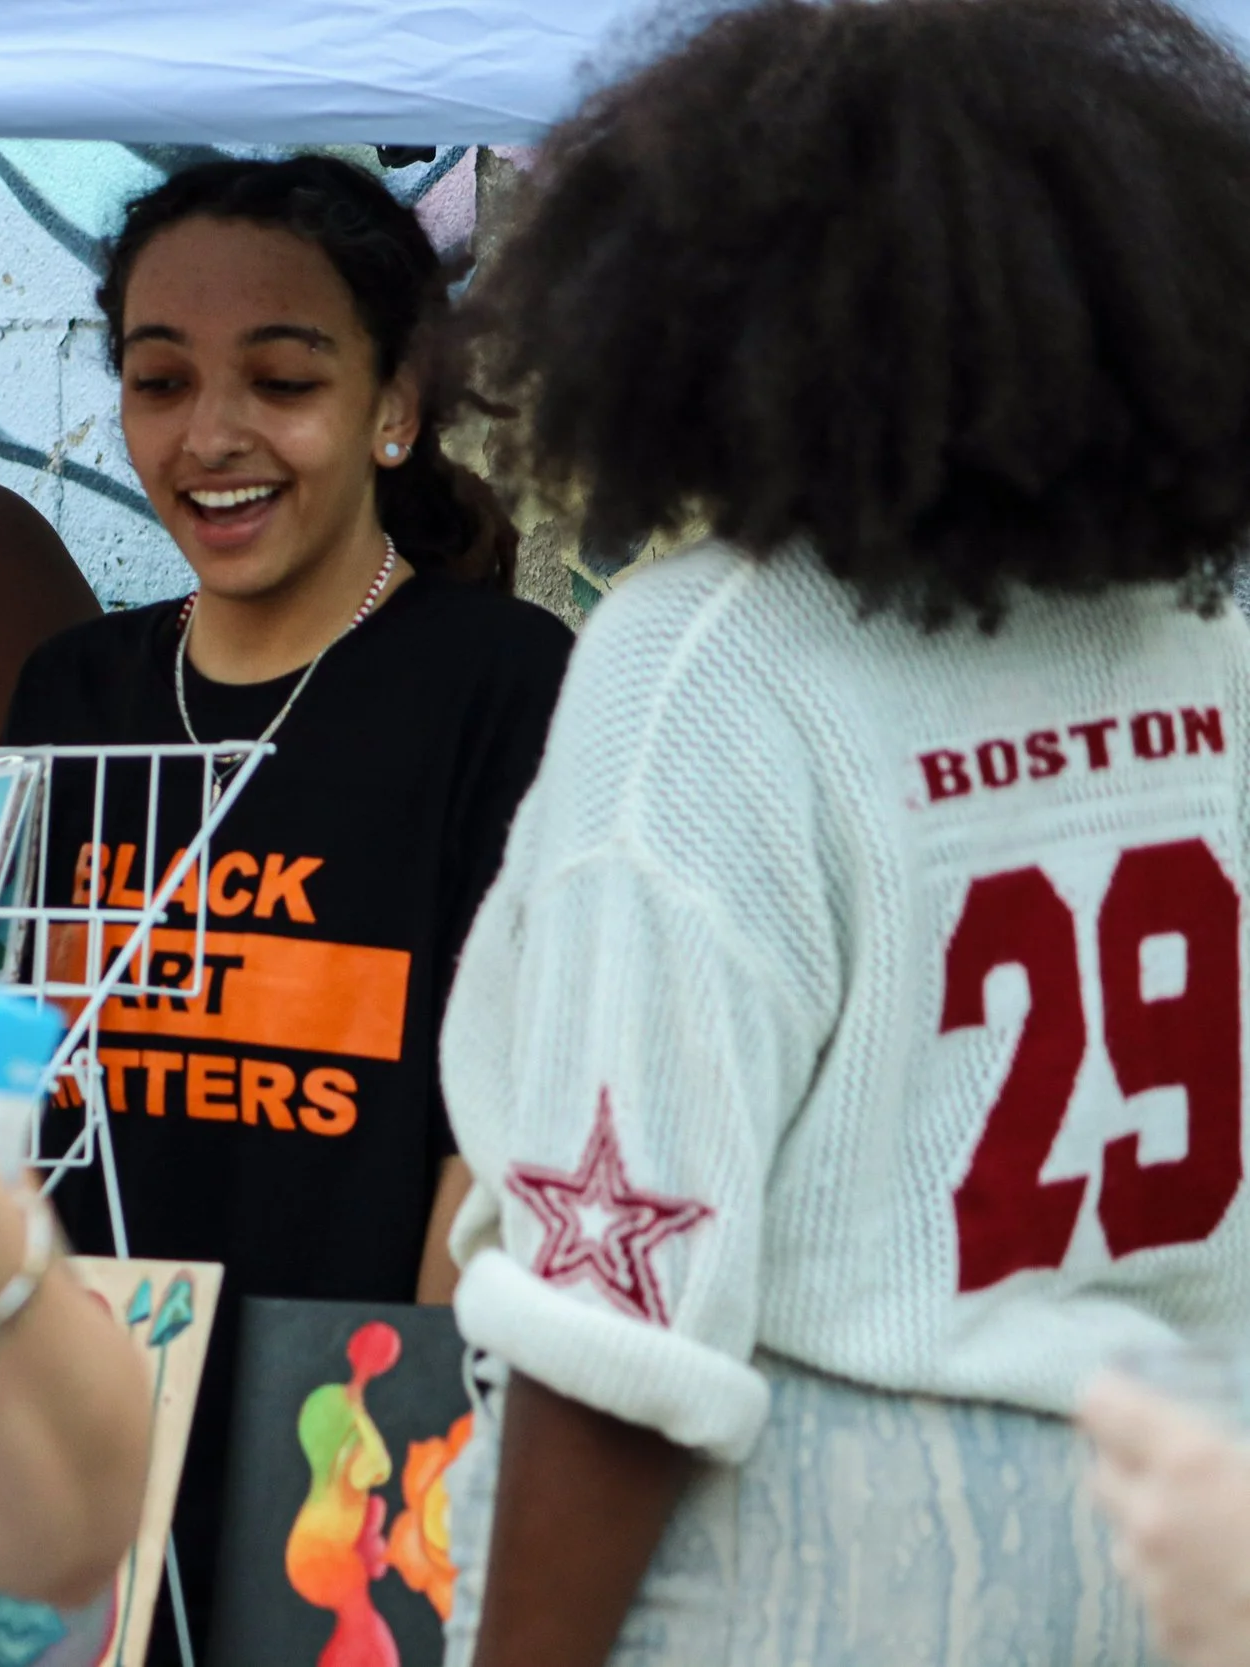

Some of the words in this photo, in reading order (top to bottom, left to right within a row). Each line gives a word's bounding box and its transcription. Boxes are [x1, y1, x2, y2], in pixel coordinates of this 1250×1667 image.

[918, 707, 1226, 803] BOSTON
[72, 843, 324, 924] BLACK
[52, 1047, 358, 1136] TTERS
[940, 837, 1244, 1293] 29
